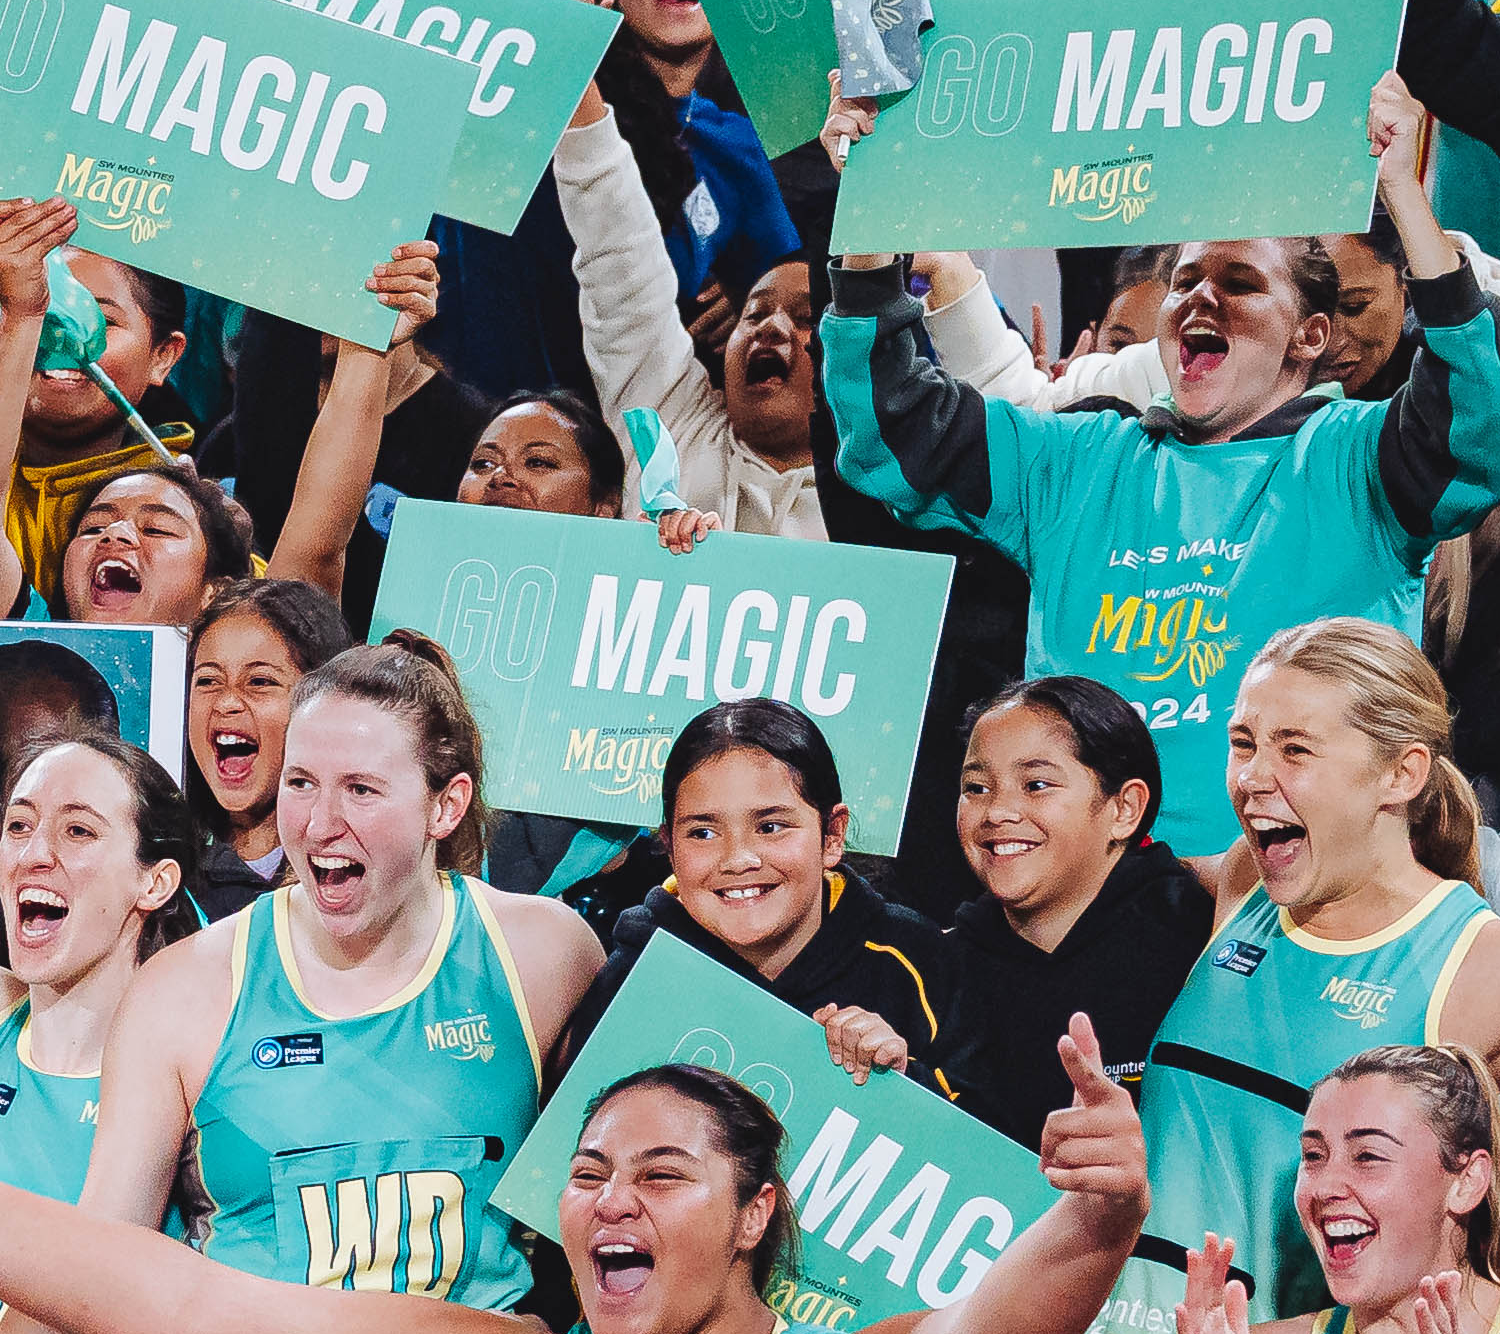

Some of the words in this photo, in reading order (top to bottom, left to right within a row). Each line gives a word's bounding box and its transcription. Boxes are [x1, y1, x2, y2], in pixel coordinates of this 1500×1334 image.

[916, 33, 1034, 138] GO
[1051, 17, 1333, 133] MAGIC
[71, 3, 388, 202] MAGIC
[55, 153, 173, 221] Magic
[98, 160, 116, 170] SW
[117, 163, 175, 183] MOUNTIES
[1048, 163, 1153, 209] Magic
[1176, 538, 1249, 563] MAKE
[435, 559, 557, 683] GO
[570, 574, 867, 717] MAGIC
[563, 728, 672, 783] Magic
[1320, 976, 1394, 1015] Magic
[284, 1047, 321, 1056] Premier
[424, 1020, 492, 1054] Magic
[284, 1055, 316, 1064] League
[1104, 1061, 1146, 1076] ountie
[298, 1170, 465, 1299] WD
[767, 1280, 858, 1332] agic
[802, 1276, 863, 1307] MOUNTIES
